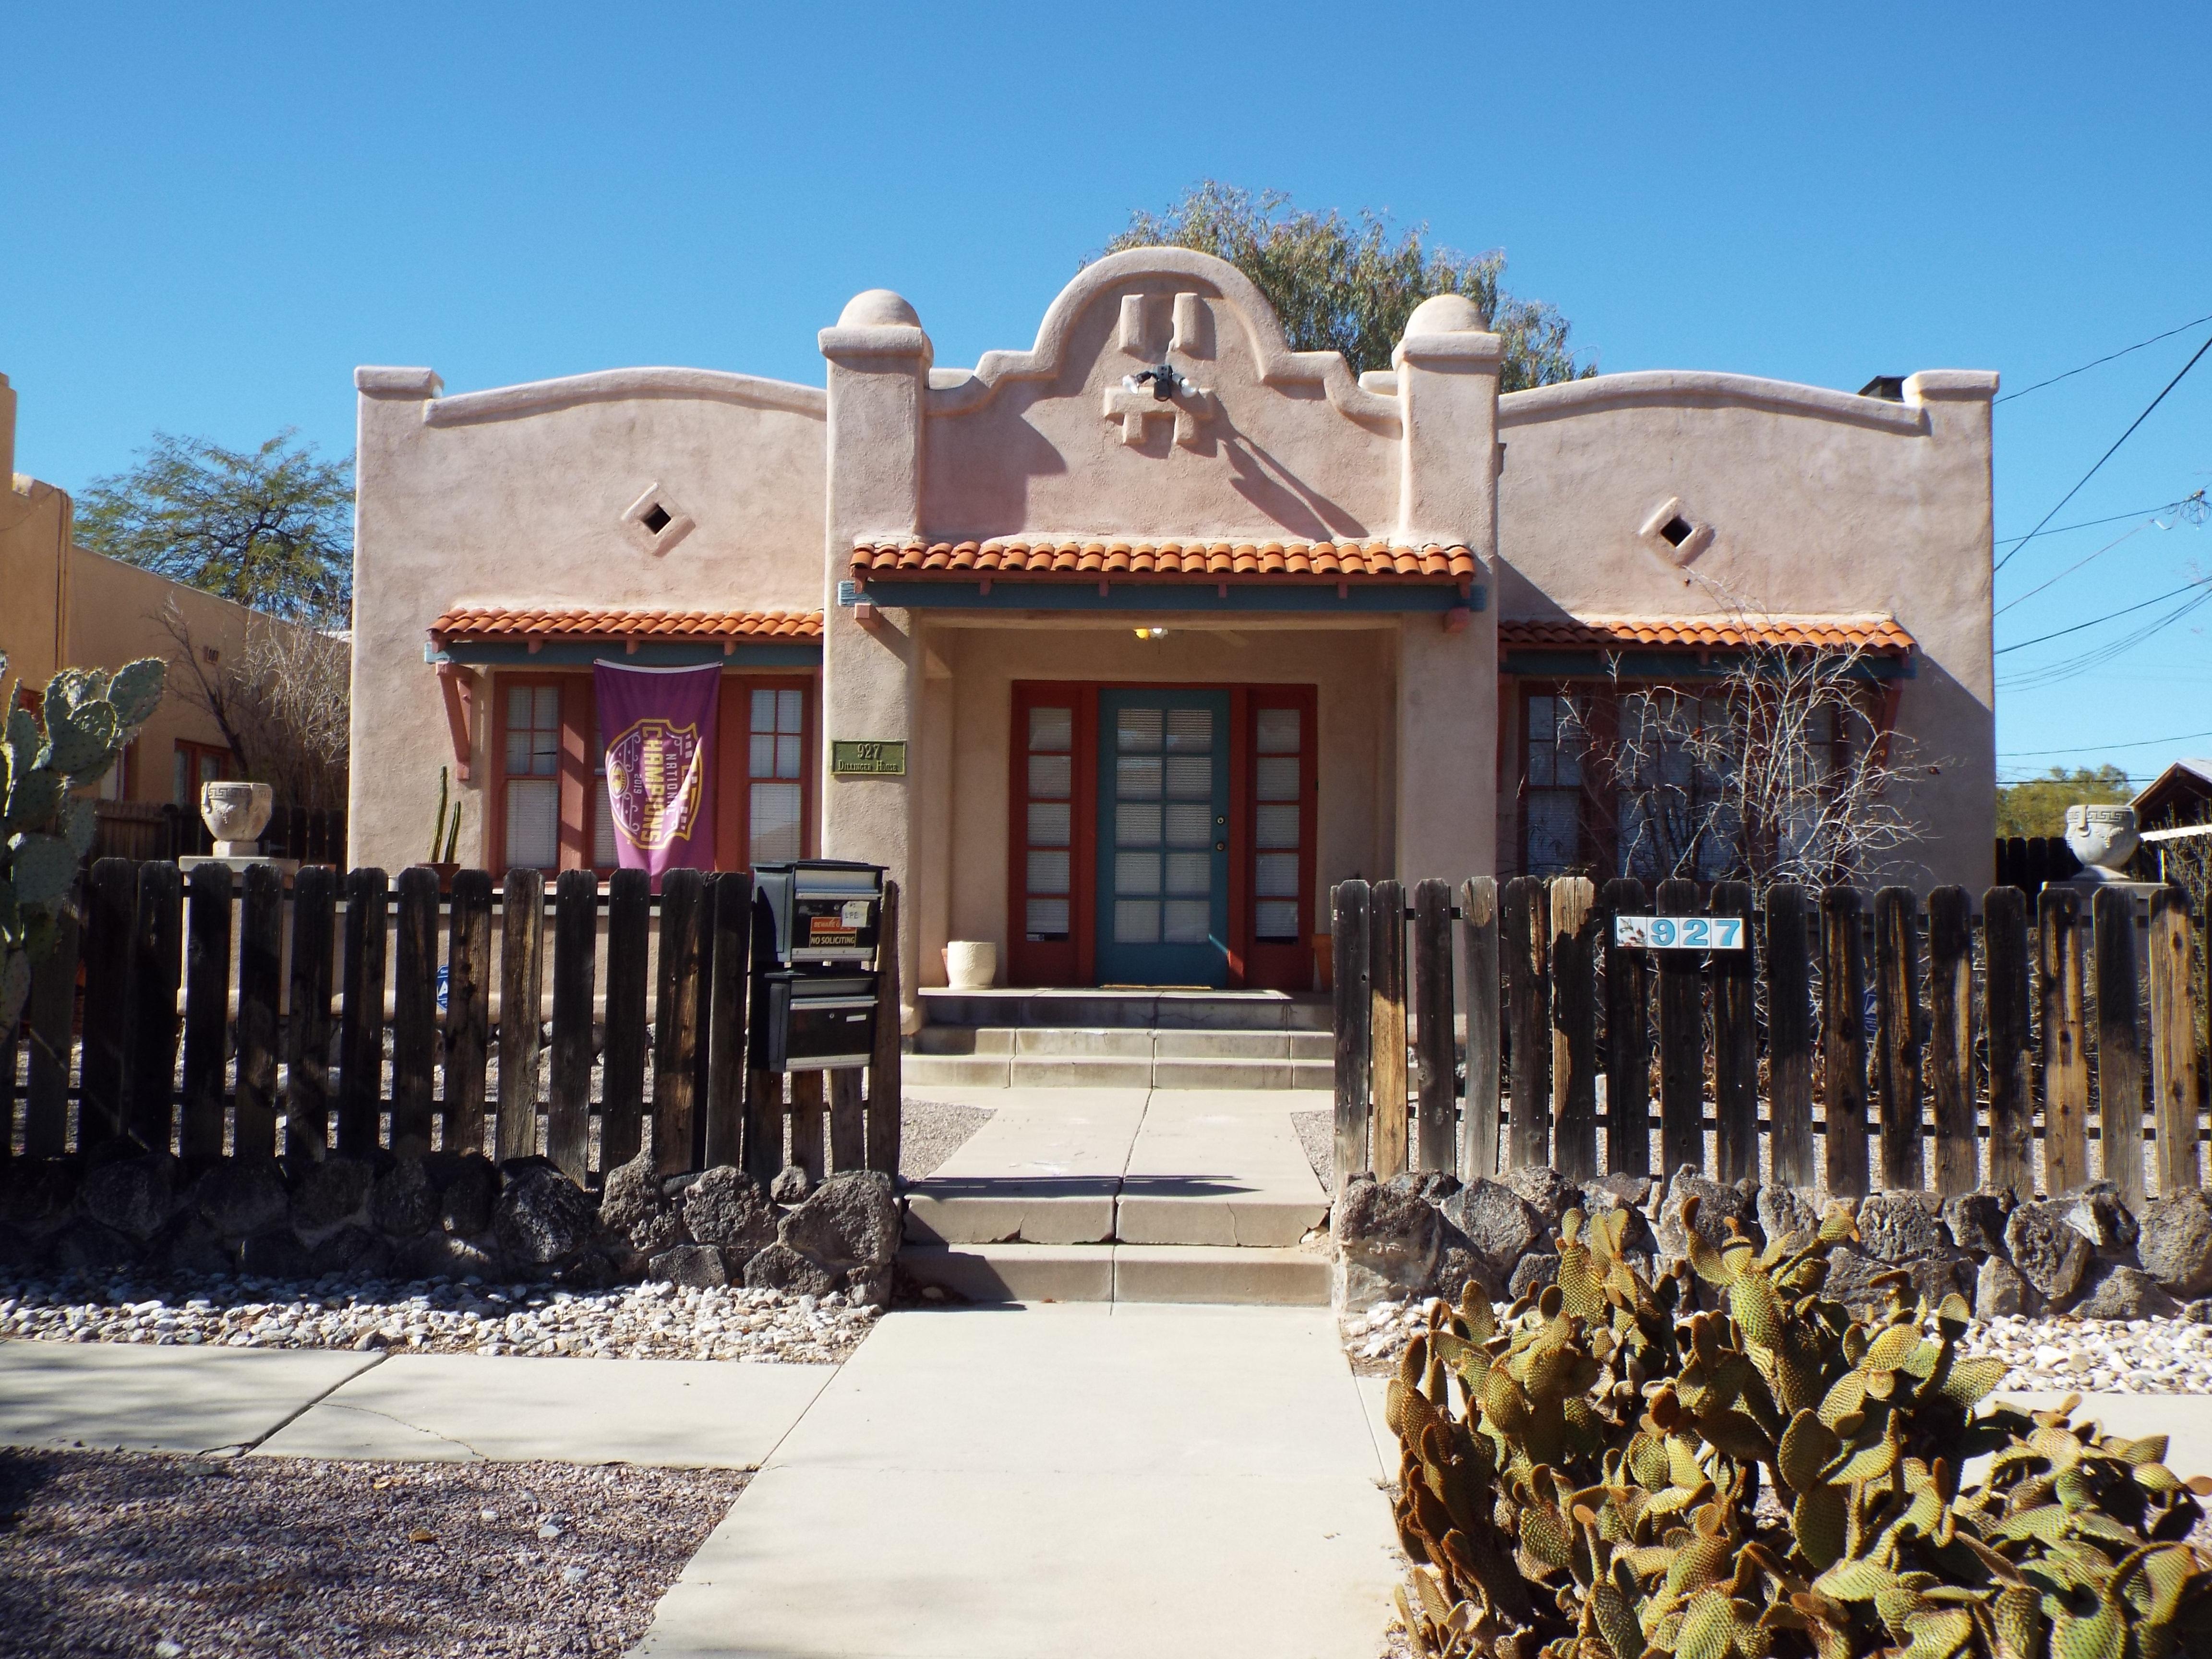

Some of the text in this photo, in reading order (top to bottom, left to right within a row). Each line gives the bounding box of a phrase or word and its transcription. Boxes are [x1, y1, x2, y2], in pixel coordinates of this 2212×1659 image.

[857, 744, 880, 759] 927
[634, 774, 642, 794] 2019
[641, 726, 665, 842] CHAMPIONS
[666, 754, 678, 815] NATIONAL
[1651, 919, 1740, 946] 927
